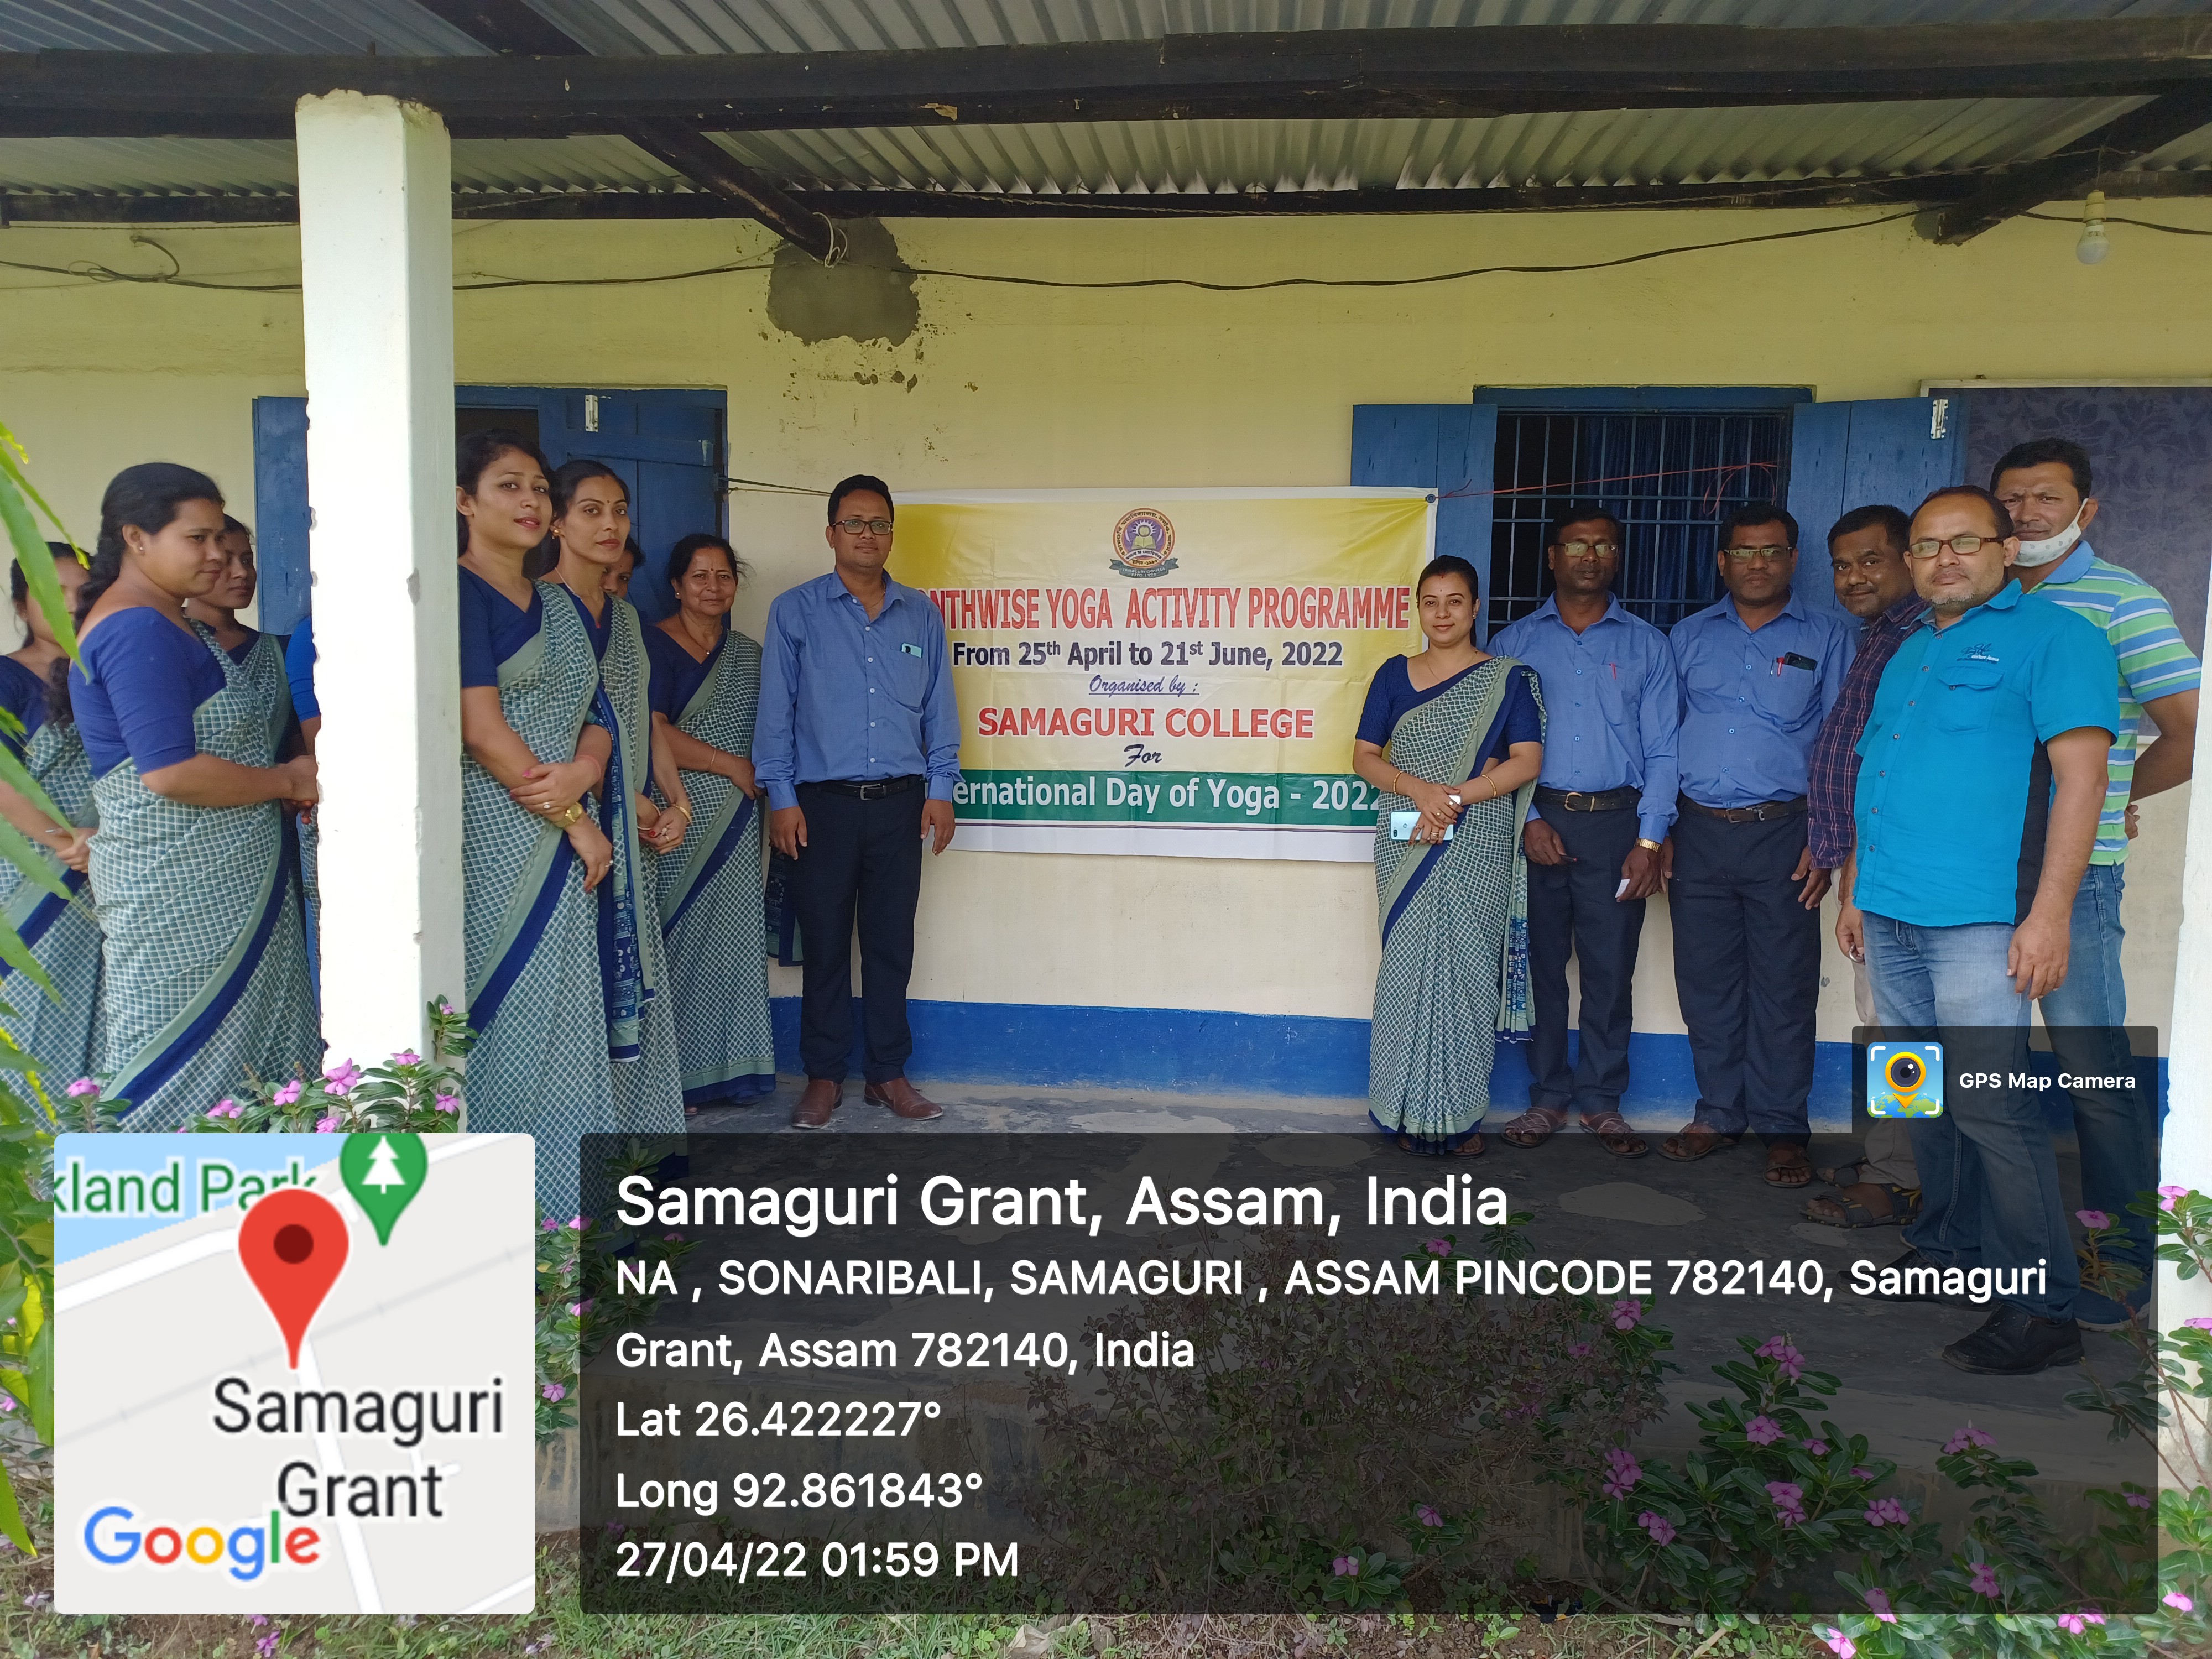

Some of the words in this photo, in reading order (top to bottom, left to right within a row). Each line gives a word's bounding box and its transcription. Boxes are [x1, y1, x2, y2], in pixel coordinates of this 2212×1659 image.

[919, 588, 1039, 629] NTHWISE
[1046, 588, 1113, 629] YOGA
[1126, 587, 1241, 629] ACTIVITY
[1248, 587, 1409, 629] PROGRAMME
[953, 643, 1010, 665] From
[1019, 640, 1061, 665] 25th
[1067, 641, 1121, 671] April
[1129, 642, 1153, 665] to
[1161, 641, 1203, 665] 21st
[1209, 641, 1273, 671] June,
[1282, 641, 1343, 666] 2022
[1089, 675, 1165, 698] Organised
[1168, 674, 1186, 697] by
[978, 708, 1154, 737] SAMAGURI
[1165, 708, 1314, 738] COLLEGE
[1124, 744, 1162, 768] For
[952, 776, 1095, 806] ernational
[1107, 778, 1160, 813] Day
[1169, 777, 1199, 808] of
[1207, 778, 1279, 816] Yoga
